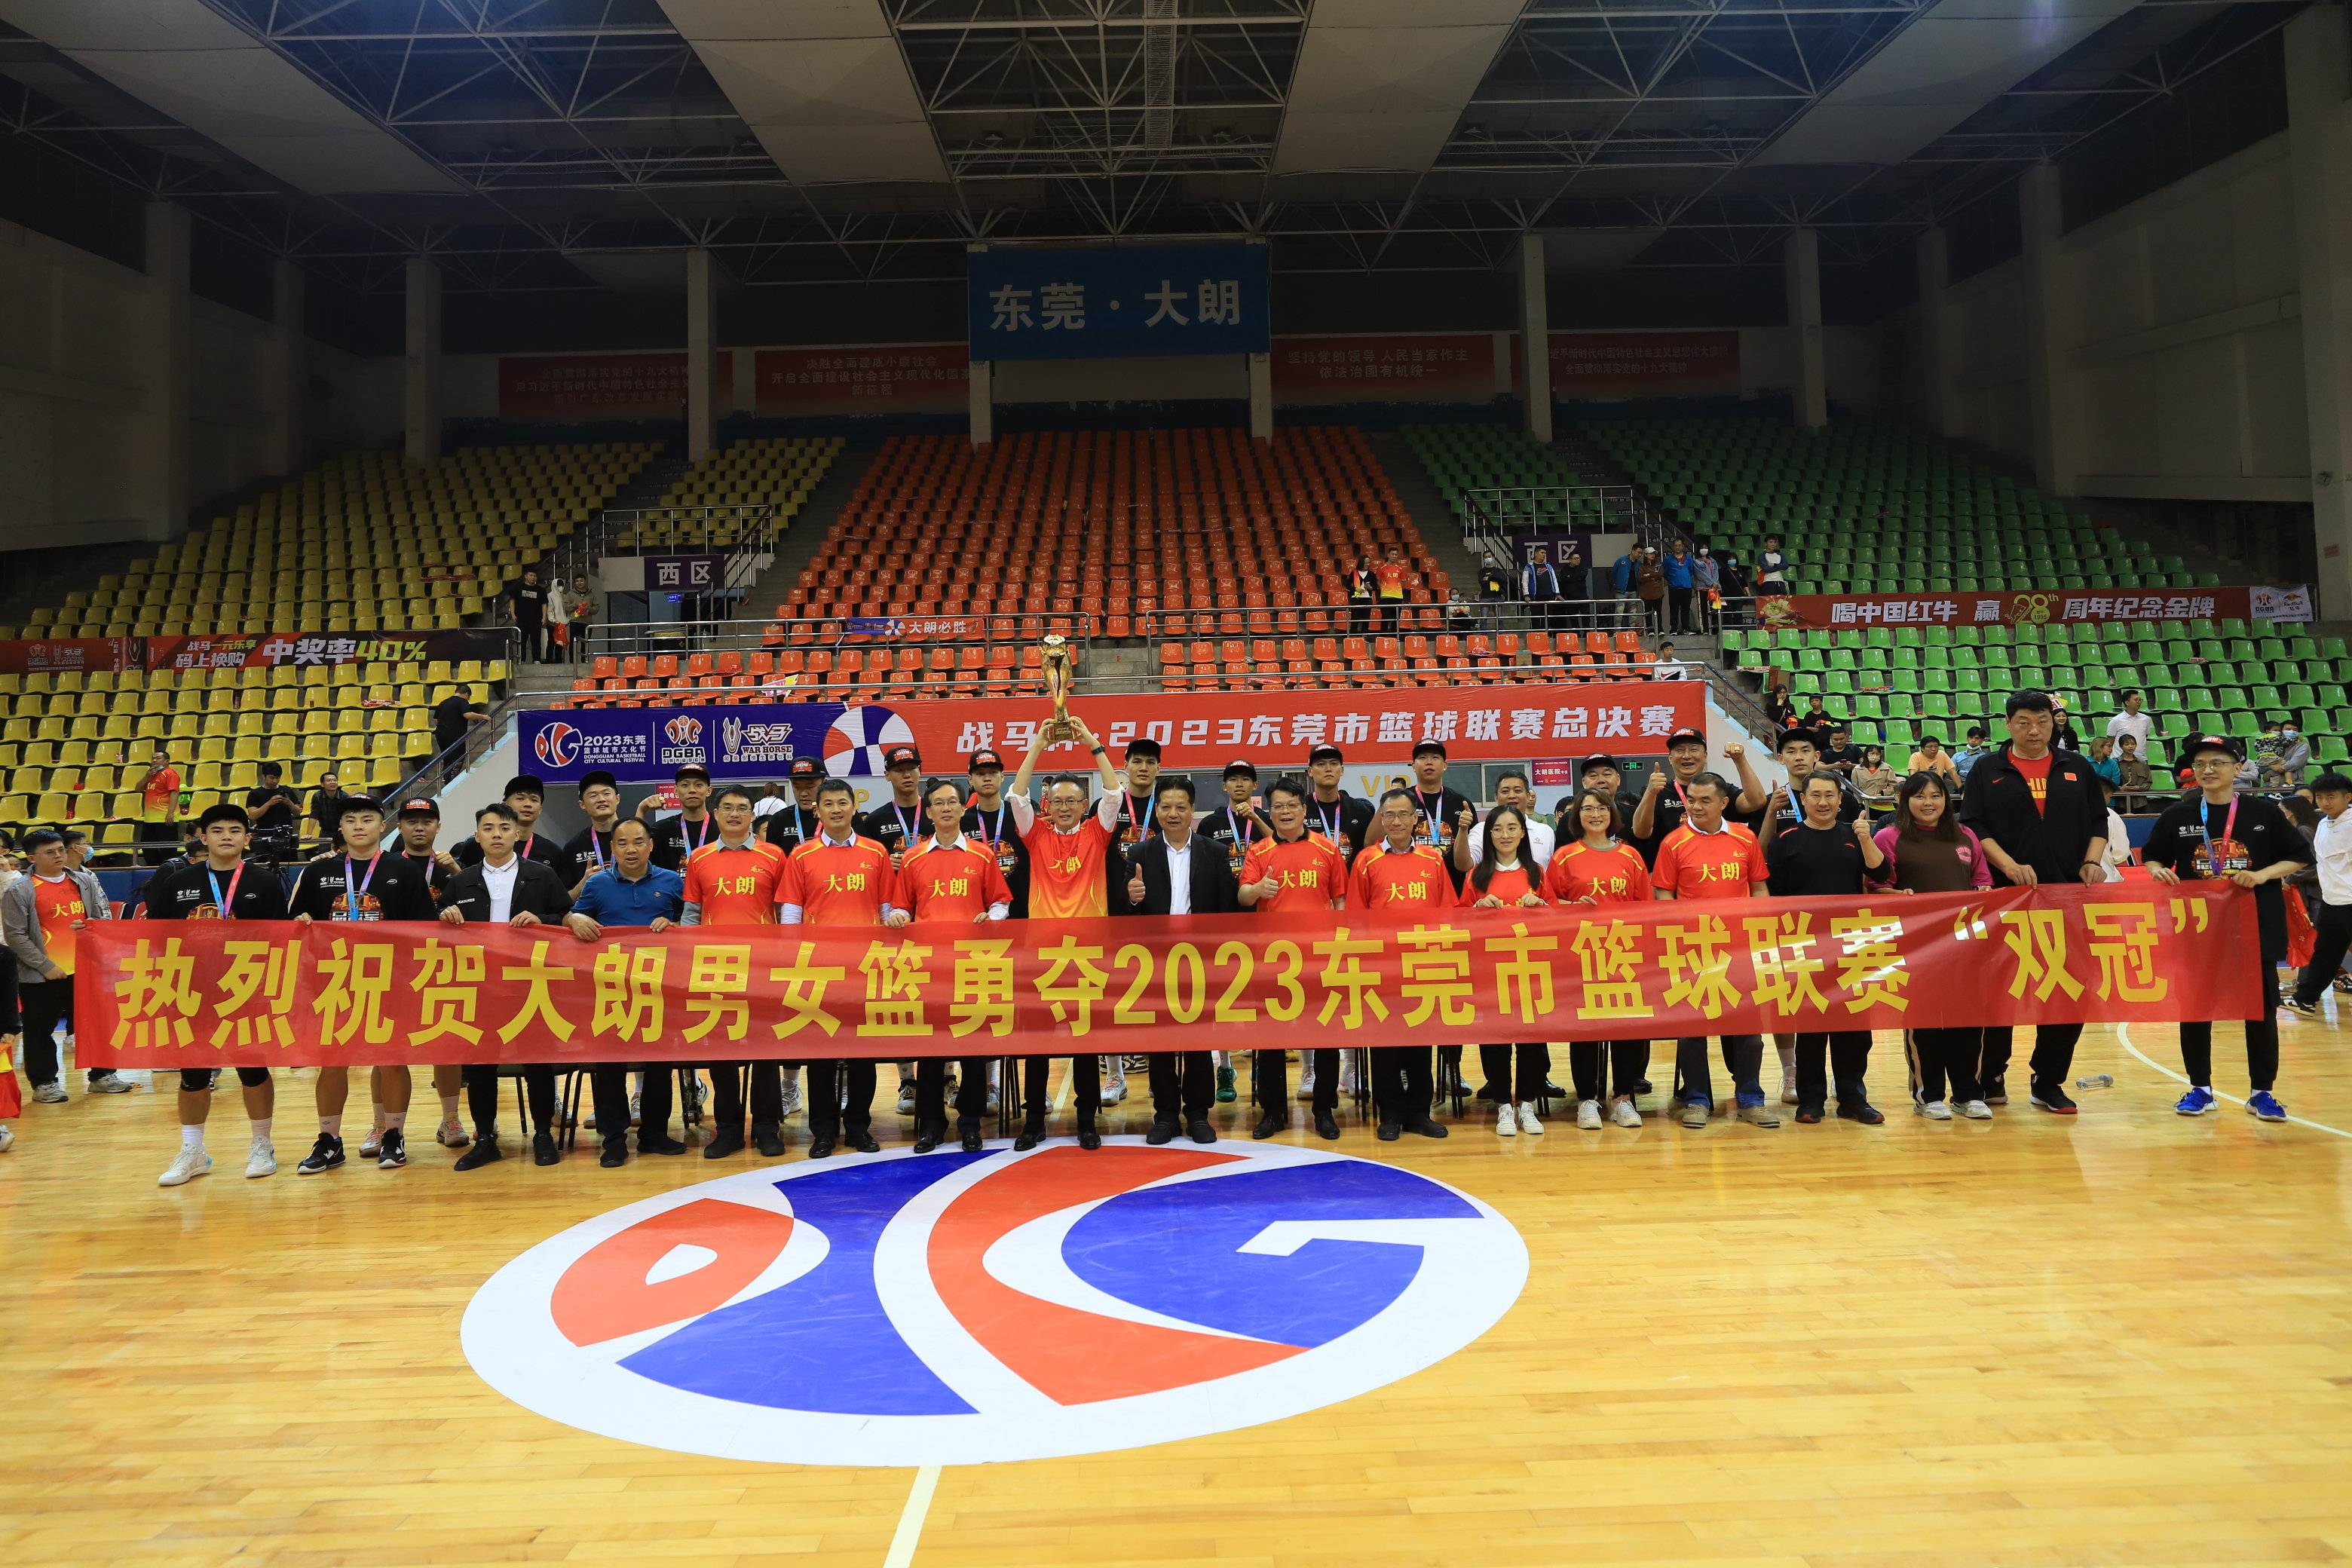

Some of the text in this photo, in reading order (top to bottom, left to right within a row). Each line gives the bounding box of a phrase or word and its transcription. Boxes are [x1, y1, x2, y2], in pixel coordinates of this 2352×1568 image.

[806, 356, 938, 370] 决胜全面建成小康社会
[1288, 348, 1468, 364] 坚持党的领导 人民当家作主
[1319, 364, 1438, 380] 依法治国有机统一
[851, 384, 893, 397] 新征程
[657, 561, 711, 586] 西区
[1830, 600, 1958, 623] 喝中国红牛
[1974, 599, 2001, 622] 赢
[2061, 597, 2216, 620] 周年纪念金牌
[908, 620, 967, 634] 大朗必胜
[186, 639, 257, 651] 战马一元乐享
[261, 638, 428, 666] 中奖率40%
[175, 652, 246, 669] 码上换购
[956, 705, 1677, 754] 战马·2023东莞市篮球联赛总决赛
[583, 734, 646, 747] 2023东莞
[583, 746, 646, 755] 篮球城市文化节
[742, 745, 792, 755] WAR HORSE
[662, 749, 705, 758] DGBA
[823, 872, 866, 894] 大朗
[1277, 869, 1318, 890] 大朗
[1696, 862, 1741, 884] 大朗
[712, 876, 757, 898] 大朗
[928, 877, 969, 899] 大朗
[1384, 880, 1427, 902] 大朗
[1587, 874, 1628, 896] 大朗
[51, 900, 85, 920] 大朗
